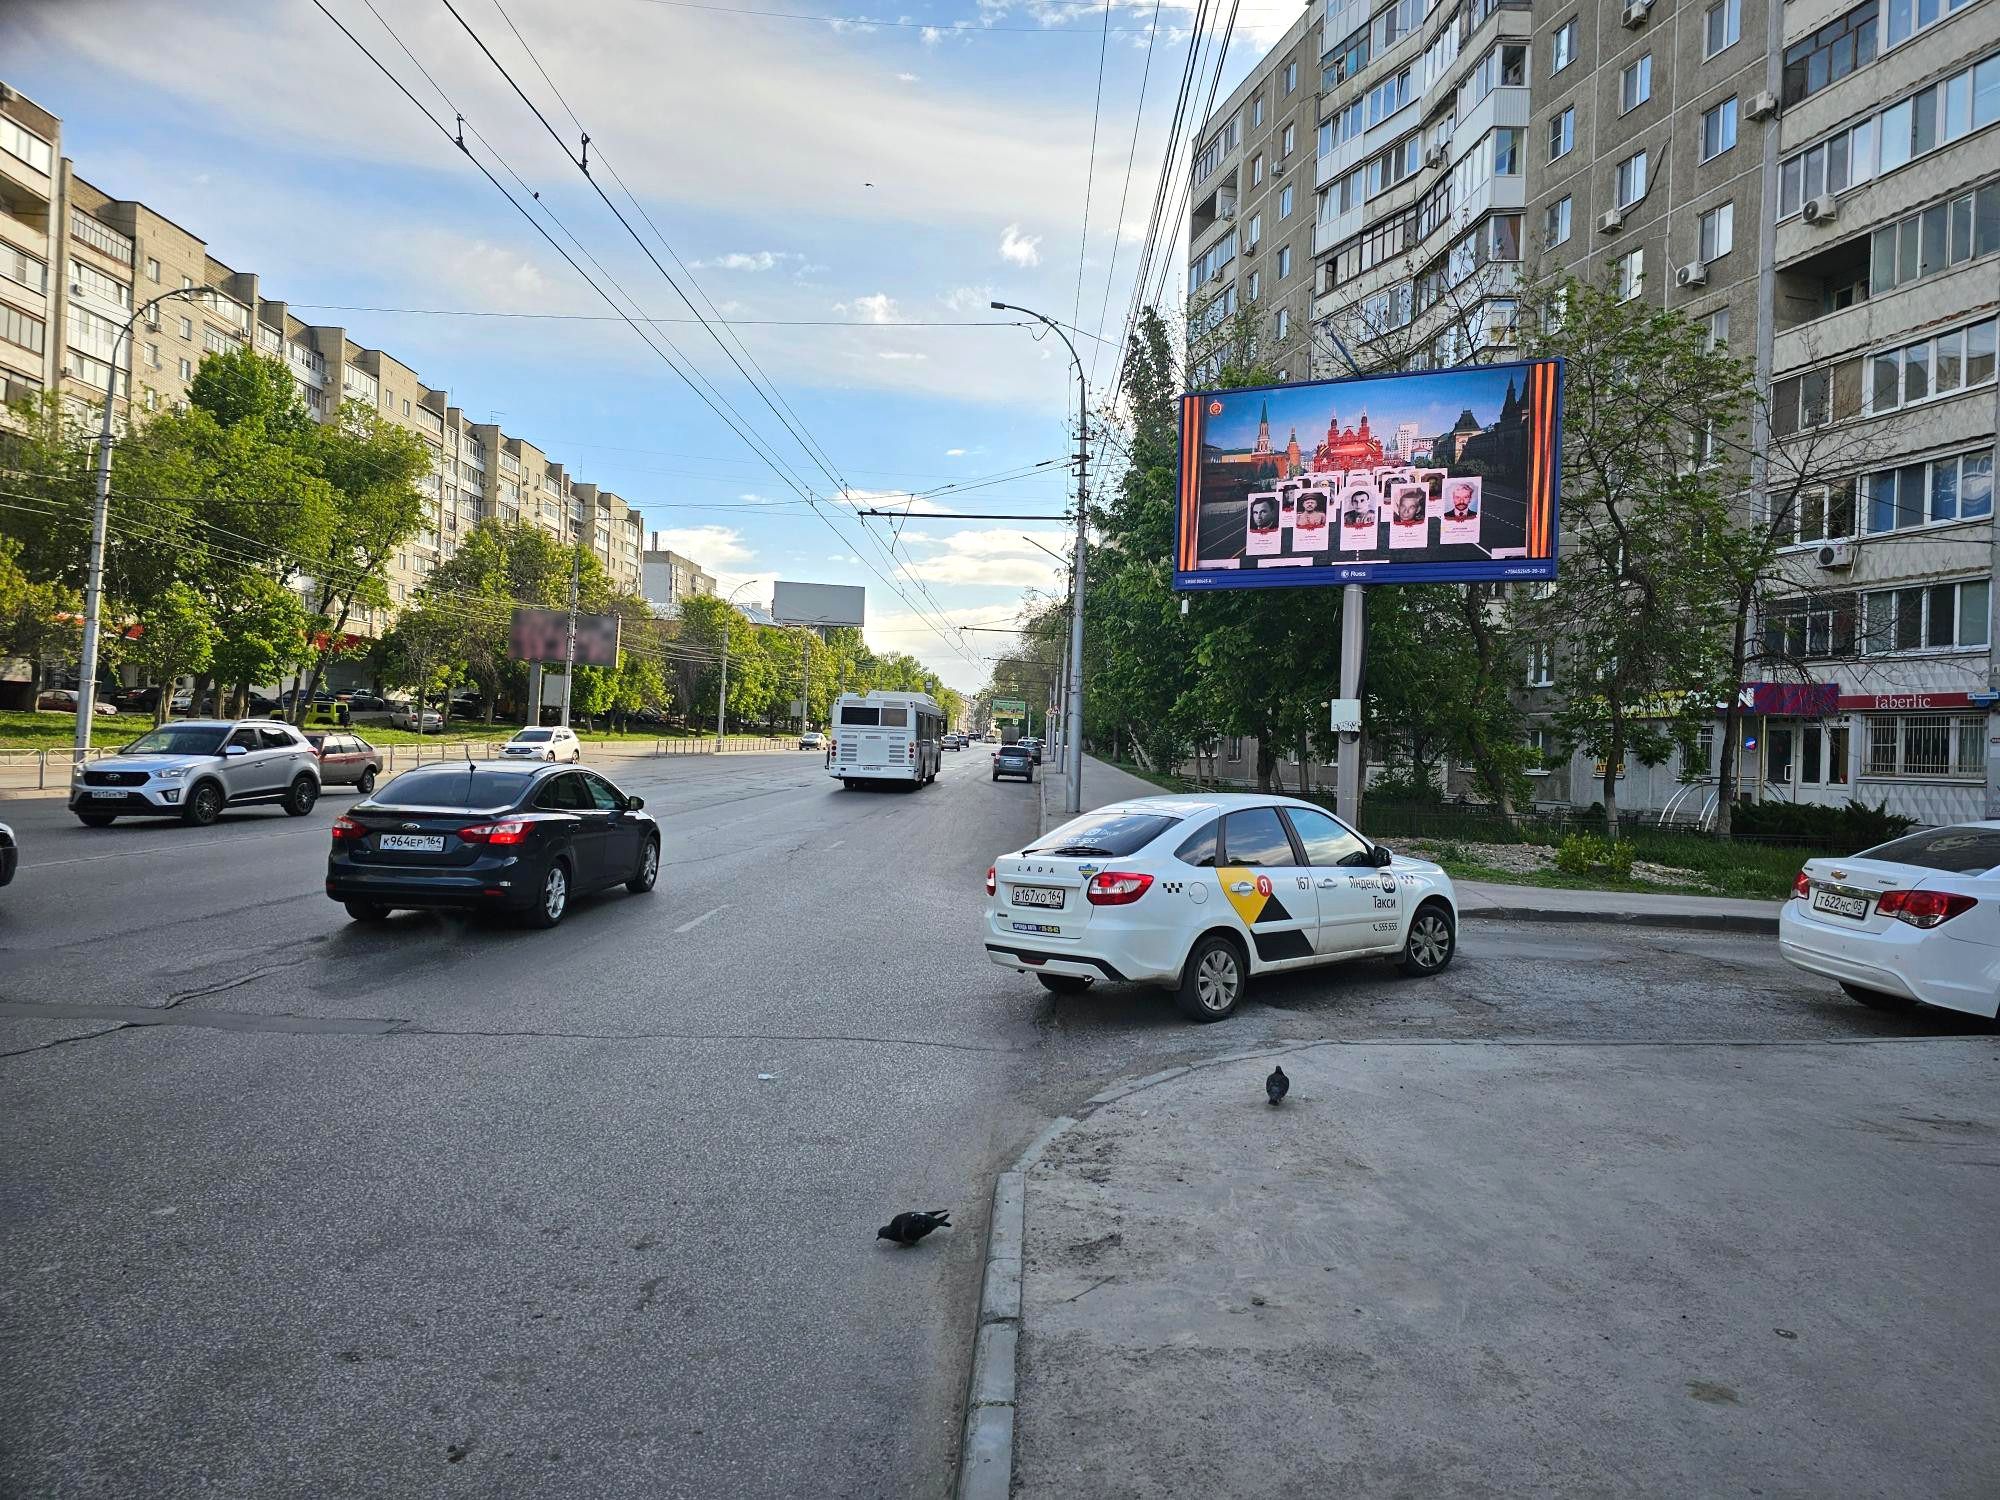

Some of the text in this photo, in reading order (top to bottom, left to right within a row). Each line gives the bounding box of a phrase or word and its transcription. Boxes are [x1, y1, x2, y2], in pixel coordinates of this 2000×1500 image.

[1874, 694, 1931, 709] faberlic
[1296, 876, 1310, 890] 167
[1348, 875, 1381, 891] Яндекс
[1372, 895, 1396, 909] Такси
